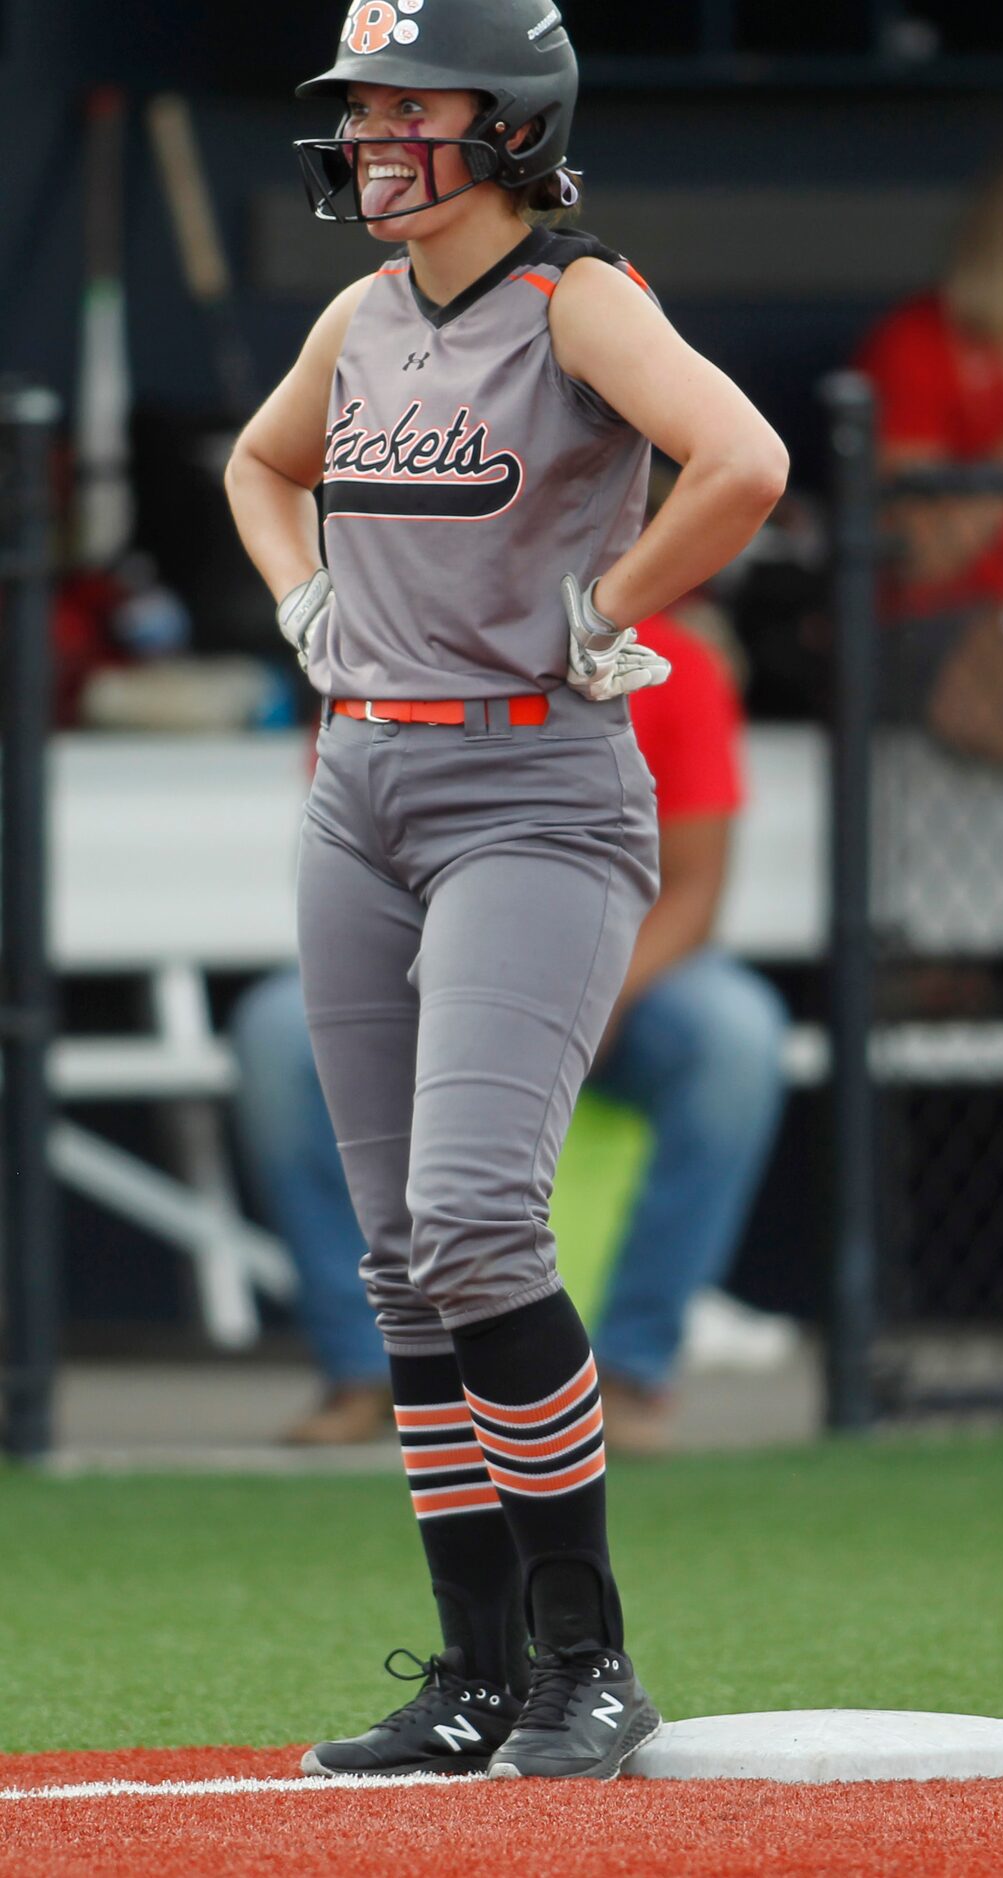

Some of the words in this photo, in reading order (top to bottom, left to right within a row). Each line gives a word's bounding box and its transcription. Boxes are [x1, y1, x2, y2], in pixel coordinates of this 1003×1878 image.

[347, 0, 397, 54] R
[591, 1691, 625, 1729] N
[433, 1714, 482, 1752] N
